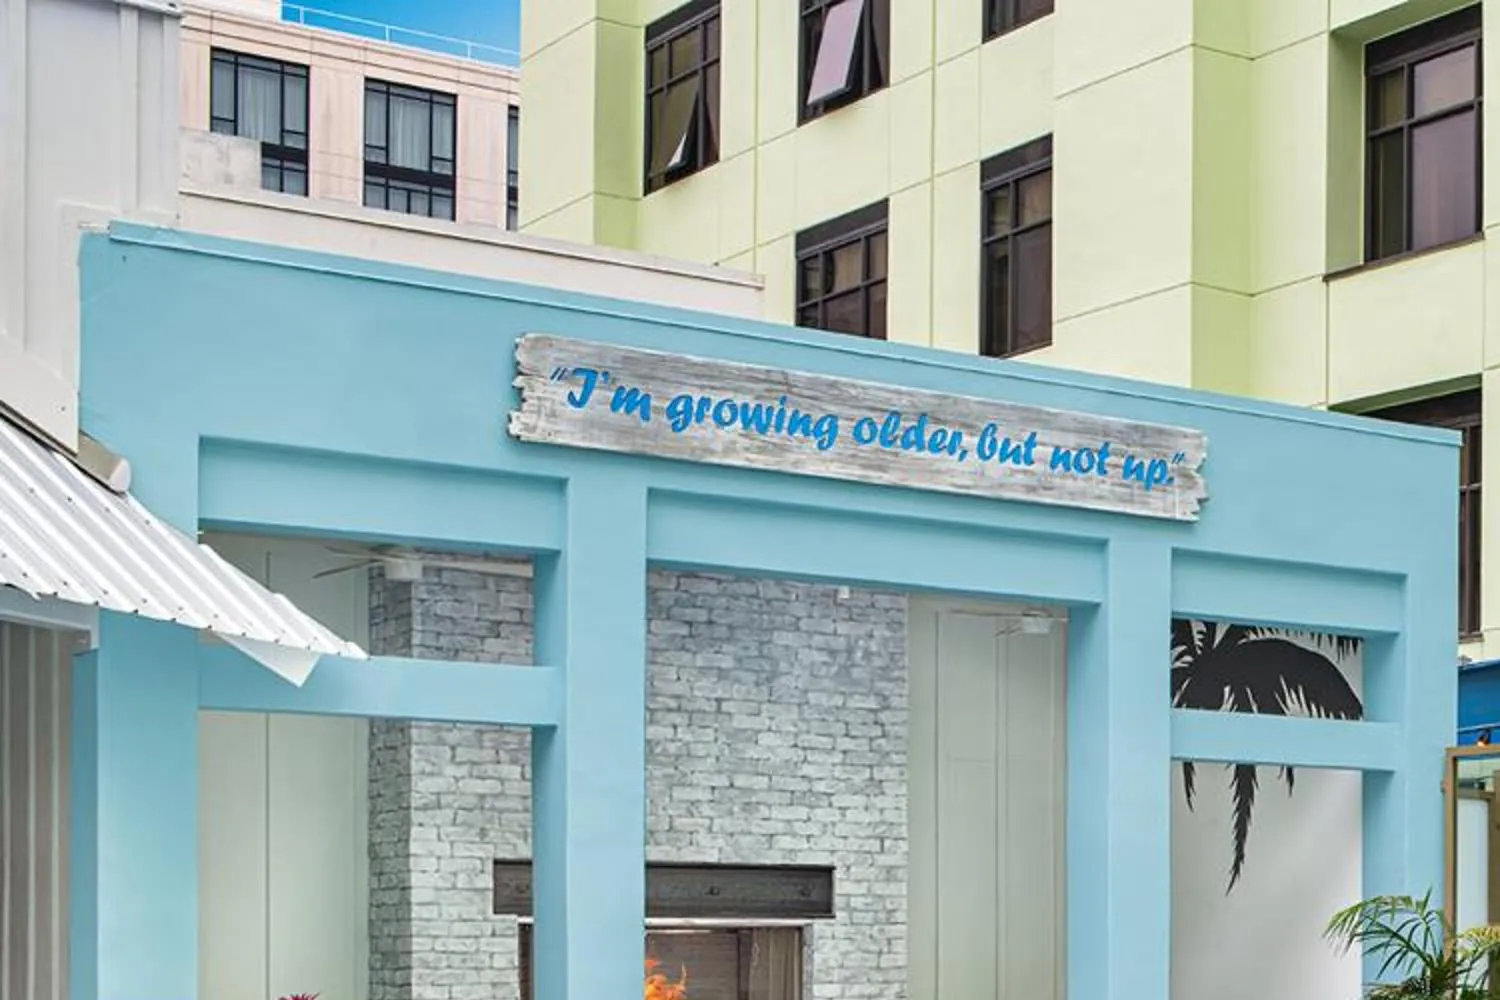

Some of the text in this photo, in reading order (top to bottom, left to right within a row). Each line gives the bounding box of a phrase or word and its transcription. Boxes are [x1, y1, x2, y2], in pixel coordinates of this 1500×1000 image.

[665, 396, 839, 450] growing
[852, 411, 968, 461] older,
[976, 423, 1038, 466] but
[1050, 443, 1111, 476] not
[1122, 450, 1186, 491] up."
